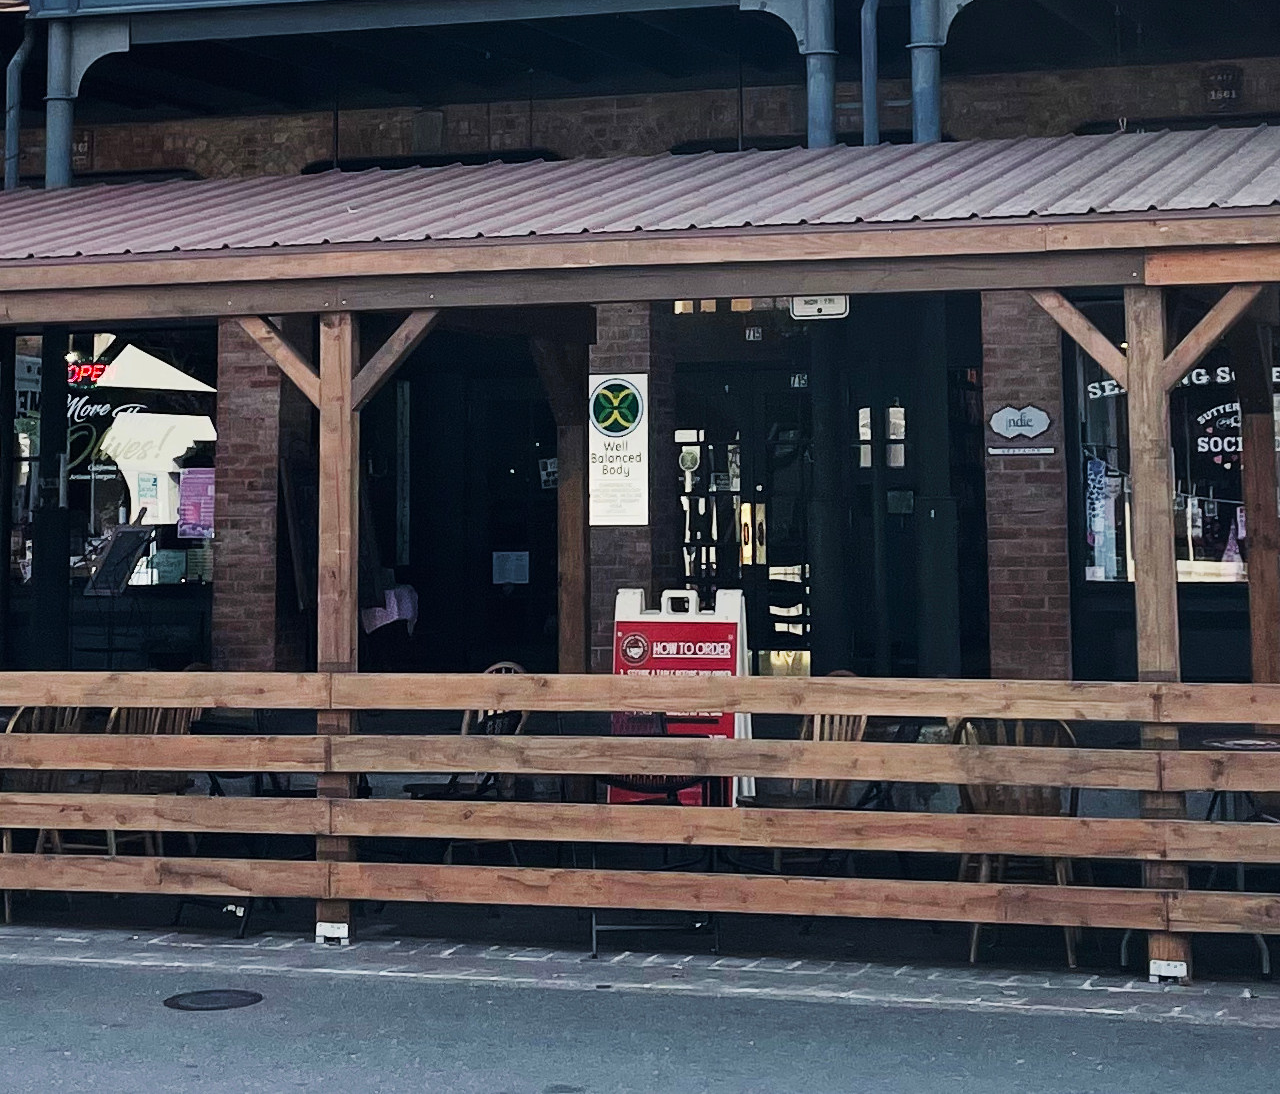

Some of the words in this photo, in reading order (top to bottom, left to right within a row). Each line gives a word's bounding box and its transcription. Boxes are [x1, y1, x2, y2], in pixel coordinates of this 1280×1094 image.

[67, 394, 112, 423] More
[1196, 402, 1241, 424] SUTTER
[603, 441, 628, 452] Well
[591, 453, 642, 464] Balanced
[602, 465, 630, 477] Body
[653, 642, 677, 655] HOW
[679, 642, 694, 655] TO
[695, 642, 731, 656] ORDER
